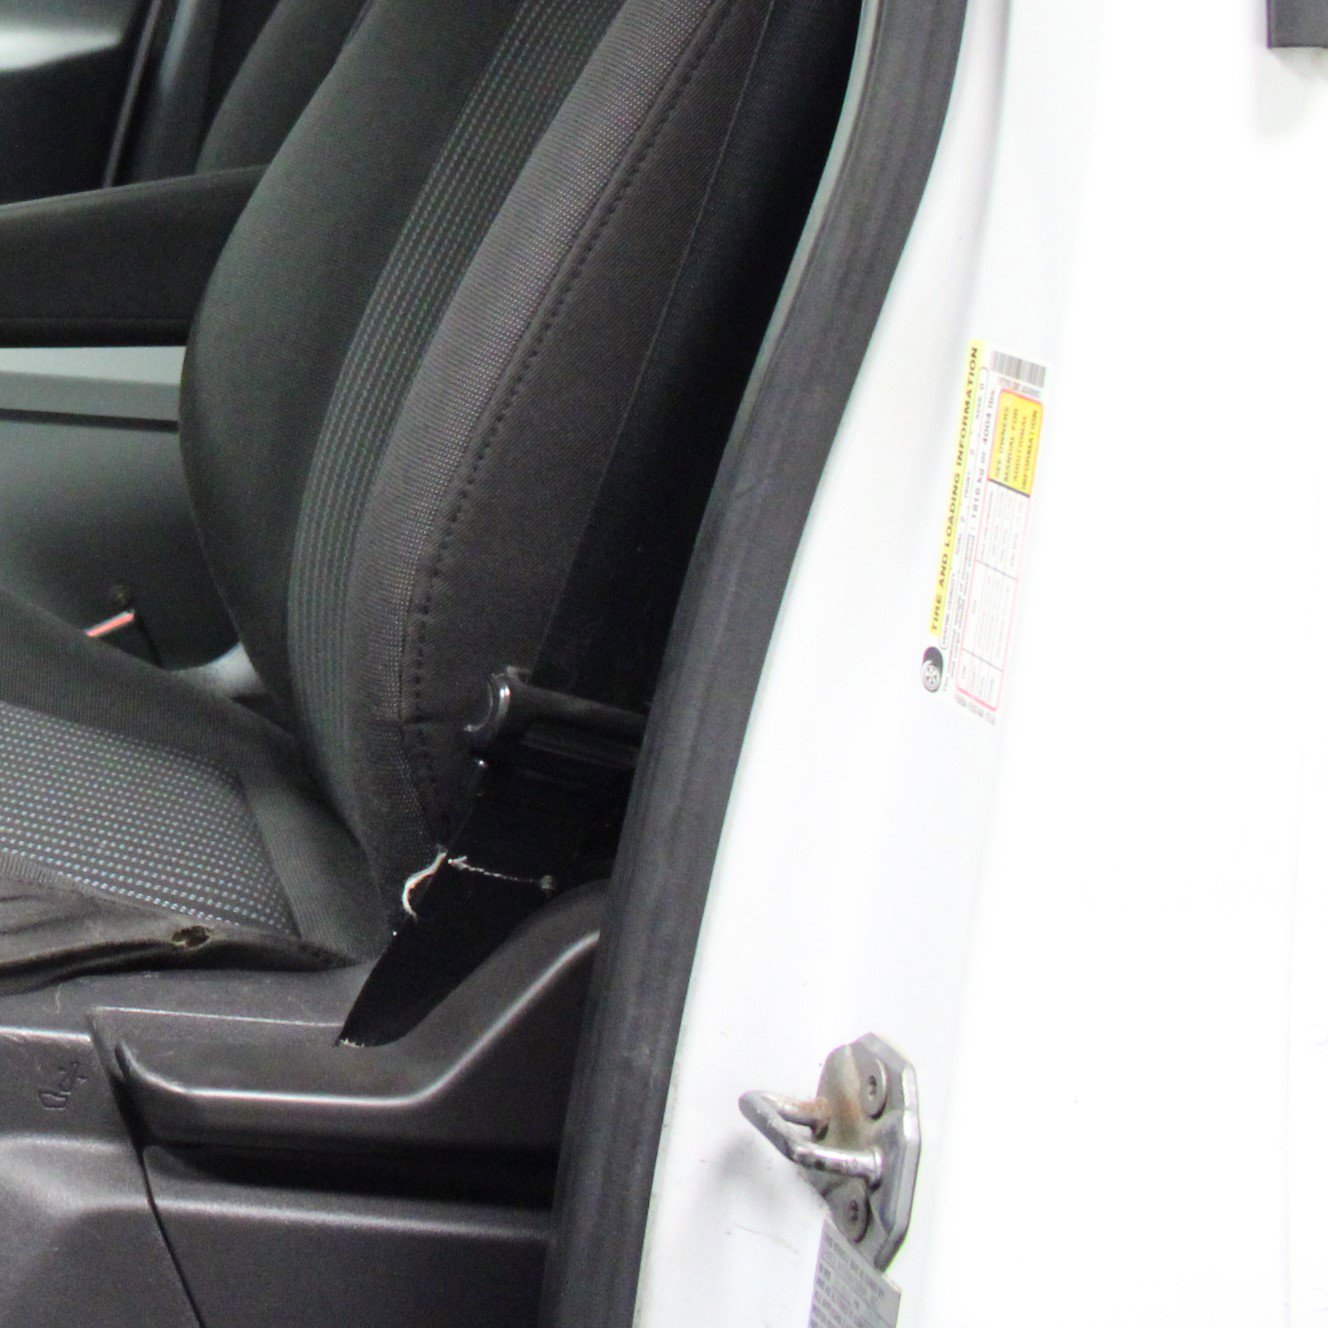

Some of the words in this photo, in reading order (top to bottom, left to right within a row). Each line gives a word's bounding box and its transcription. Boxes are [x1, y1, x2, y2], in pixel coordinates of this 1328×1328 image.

[982, 411, 992, 445] 4004
[1003, 434, 1015, 482] MANUAL
[1012, 414, 1027, 482] ADDITIONAL
[1020, 409, 1037, 489] INFORMATION
[938, 552, 948, 588] AND
[944, 471, 960, 548] LOADING
[955, 346, 977, 467] INFORMATION
